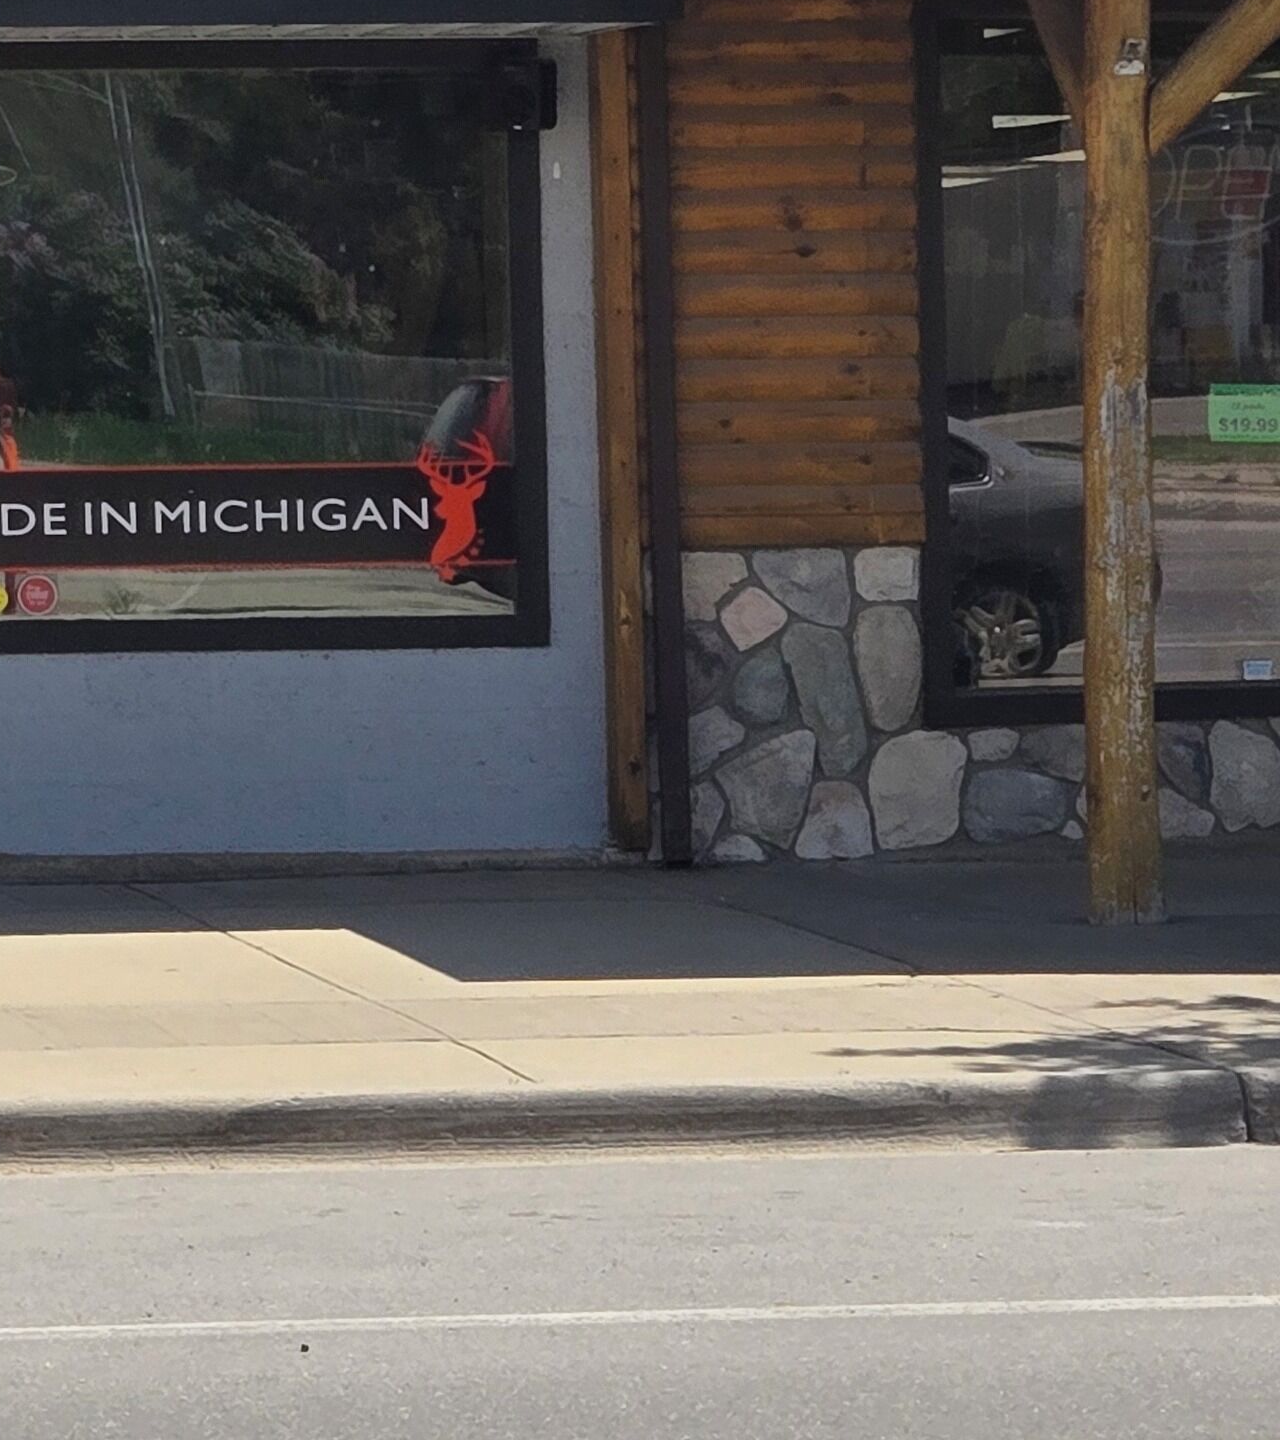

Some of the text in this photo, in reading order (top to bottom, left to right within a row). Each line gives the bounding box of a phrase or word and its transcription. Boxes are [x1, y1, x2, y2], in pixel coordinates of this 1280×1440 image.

[1219, 417, 1278, 433] $19.99
[85, 501, 137, 535] IN
[154, 497, 429, 534] MICHIGAN
